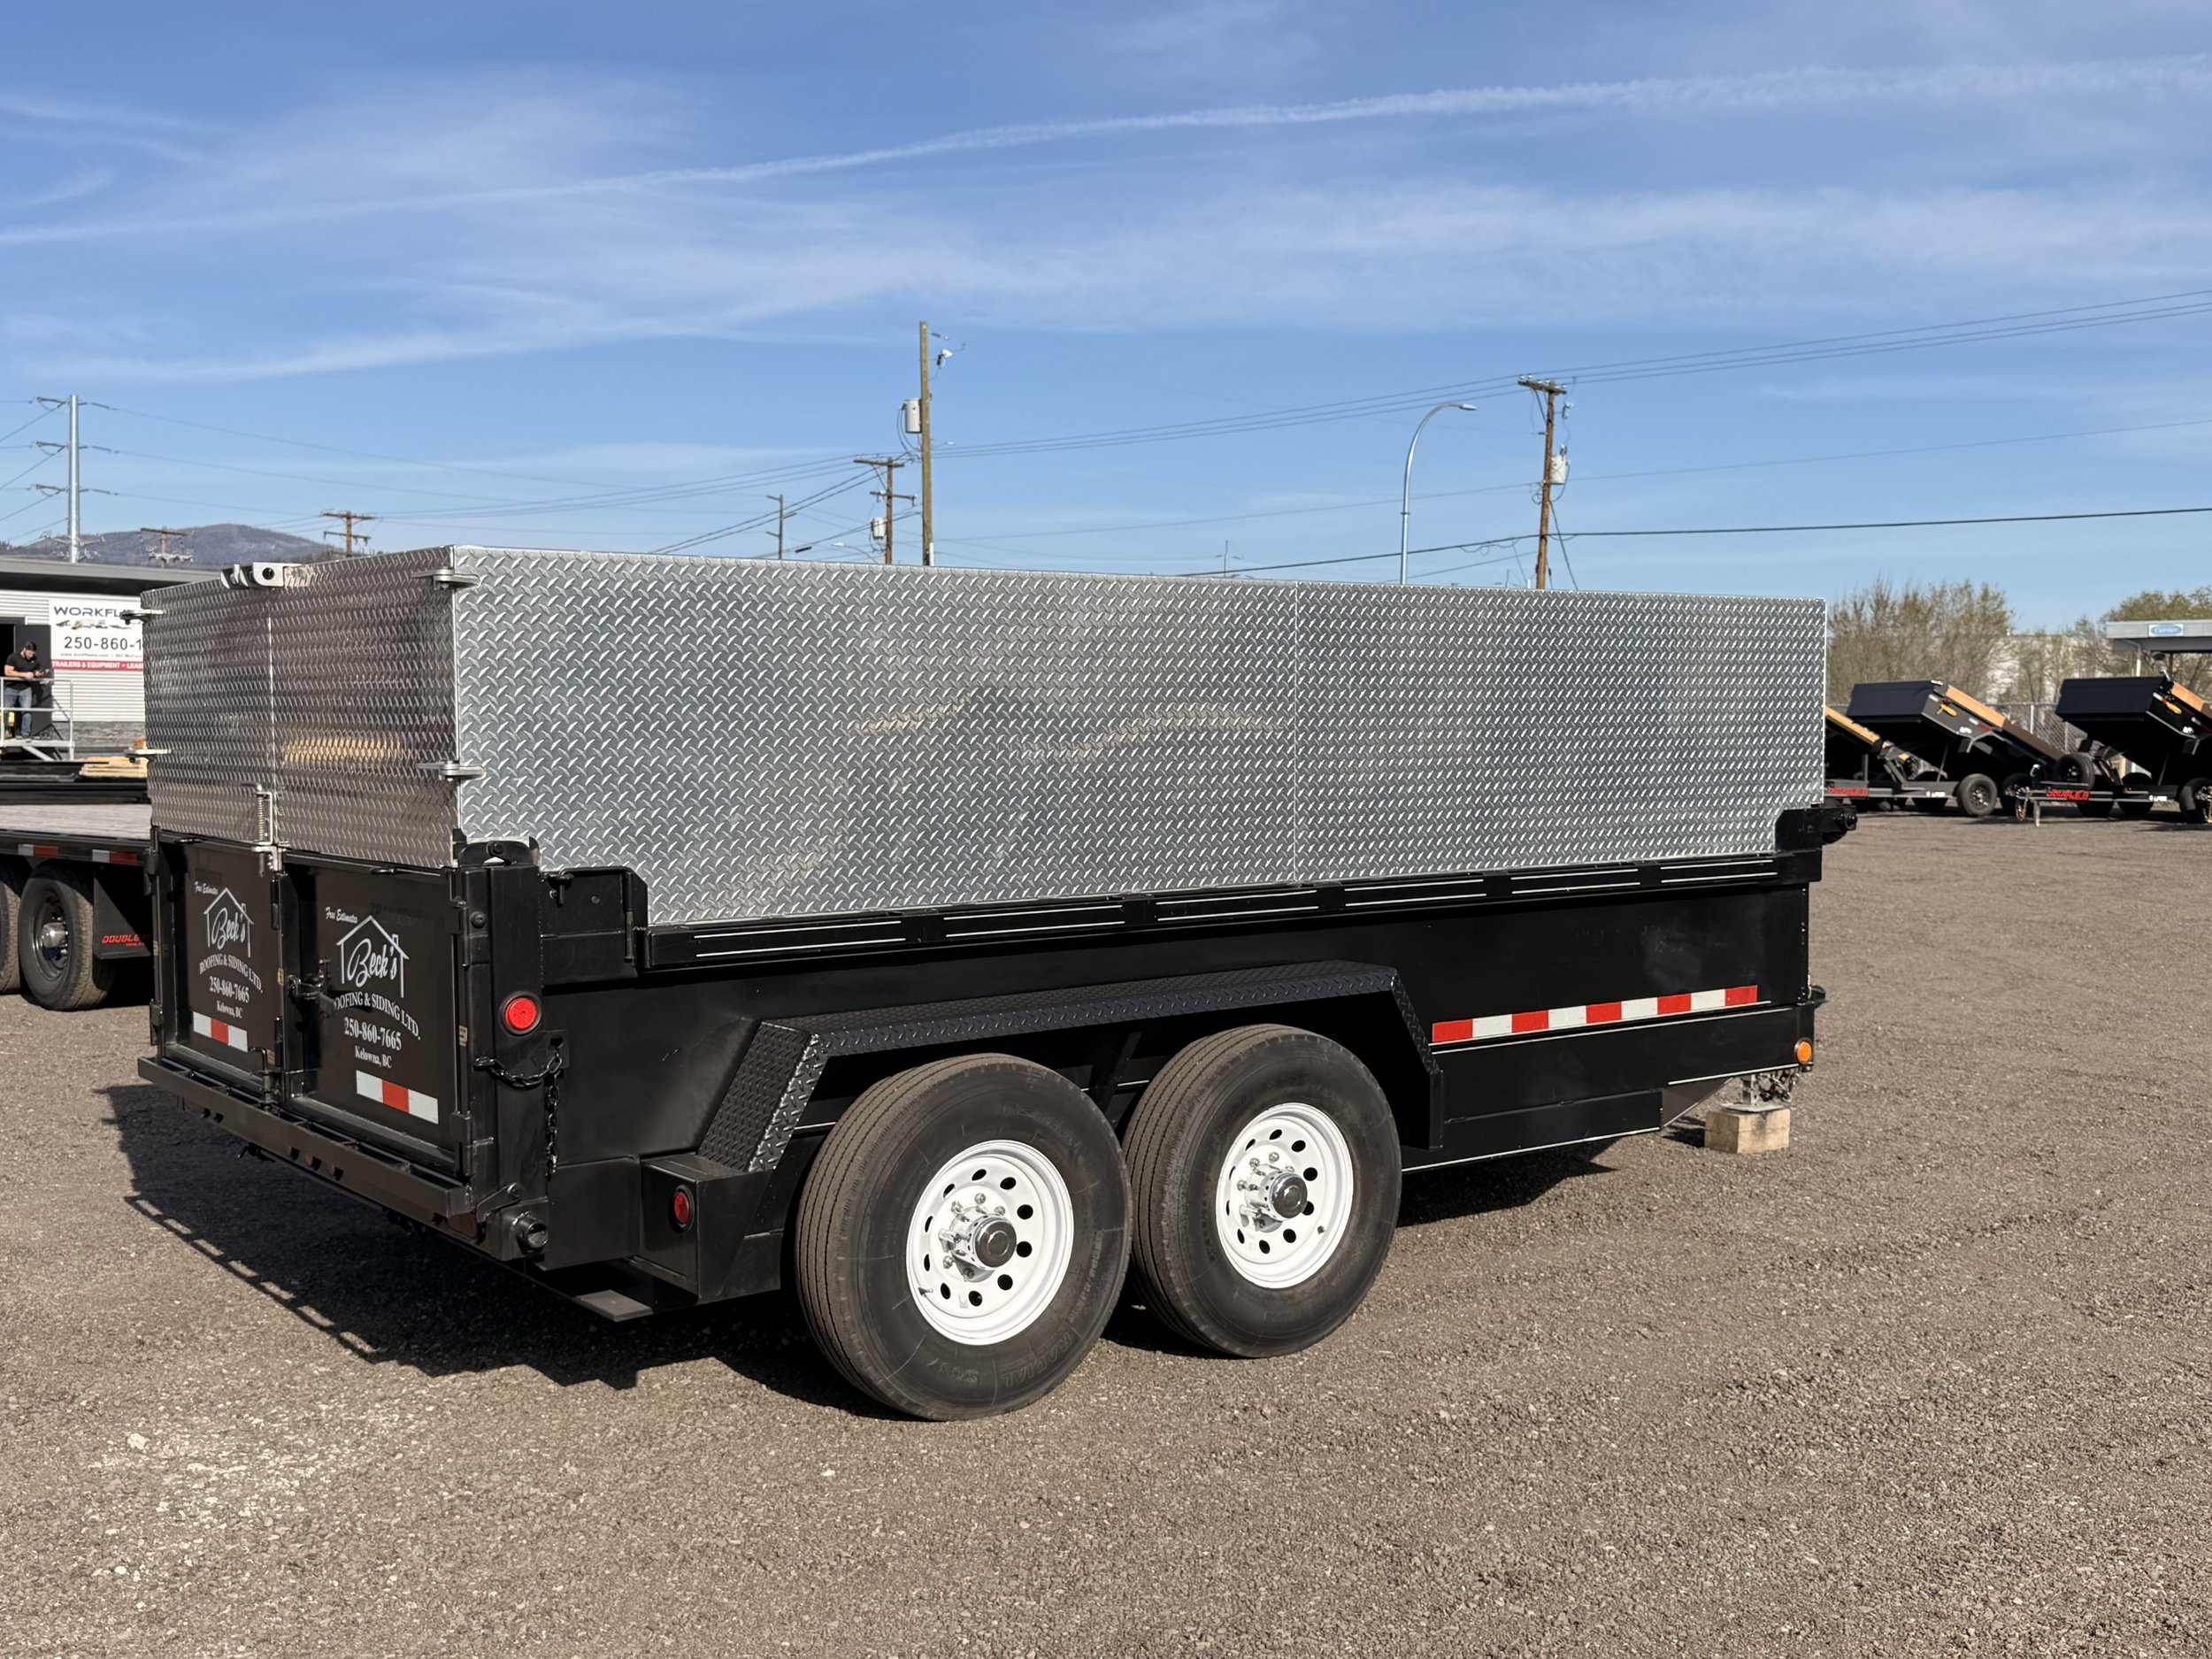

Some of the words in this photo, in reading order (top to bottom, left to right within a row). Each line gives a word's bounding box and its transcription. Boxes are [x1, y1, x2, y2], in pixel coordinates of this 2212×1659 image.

[53, 605, 121, 618] WORKFL
[64, 636, 142, 651] 250-860-1
[326, 906, 335, 920] Free
[335, 908, 358, 924] Estimates
[211, 907, 246, 950] Beck's
[199, 953, 223, 975] ROOFING
[223, 954, 228, 967] &
[227, 955, 249, 979] SIDING
[347, 938, 398, 987] Beck's
[210, 976, 250, 1003] 250-860-7665
[235, 1006, 243, 1019] BC
[334, 991, 364, 1012] OOFING
[364, 993, 371, 1007] &
[371, 993, 401, 1022] SIDING
[401, 1009, 421, 1041] LTD.
[344, 1017, 402, 1051] 250-860-7665
[355, 1044, 382, 1068] Kelowna,
[381, 1055, 392, 1069] BC
